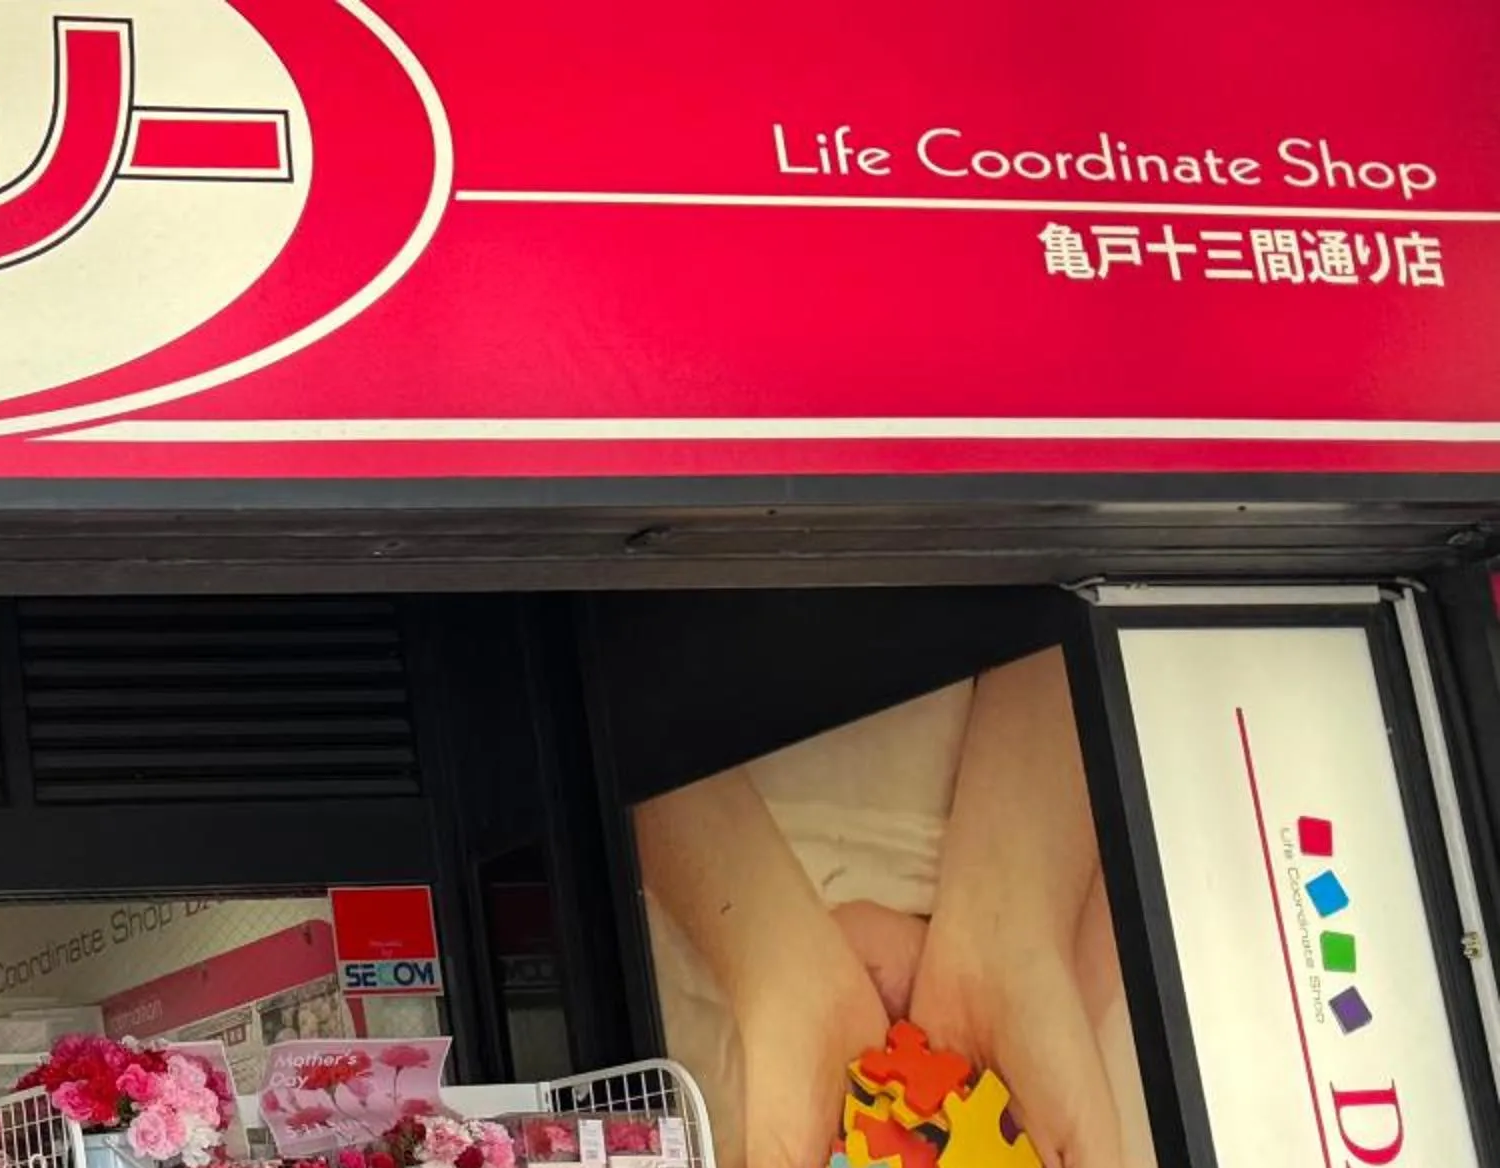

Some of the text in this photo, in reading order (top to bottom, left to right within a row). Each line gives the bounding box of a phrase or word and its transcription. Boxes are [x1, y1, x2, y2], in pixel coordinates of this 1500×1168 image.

[773, 124, 1438, 200] Life Coordinate Shop
[1037, 222, 1445, 287] 亀戸十三間通り店
[111, 900, 173, 945] Shop
[1280, 827, 1325, 1025] Life Coordinate Shop
[345, 962, 434, 986] SECOM
[270, 1073, 309, 1089] Day
[275, 1052, 358, 1068] Mother's
